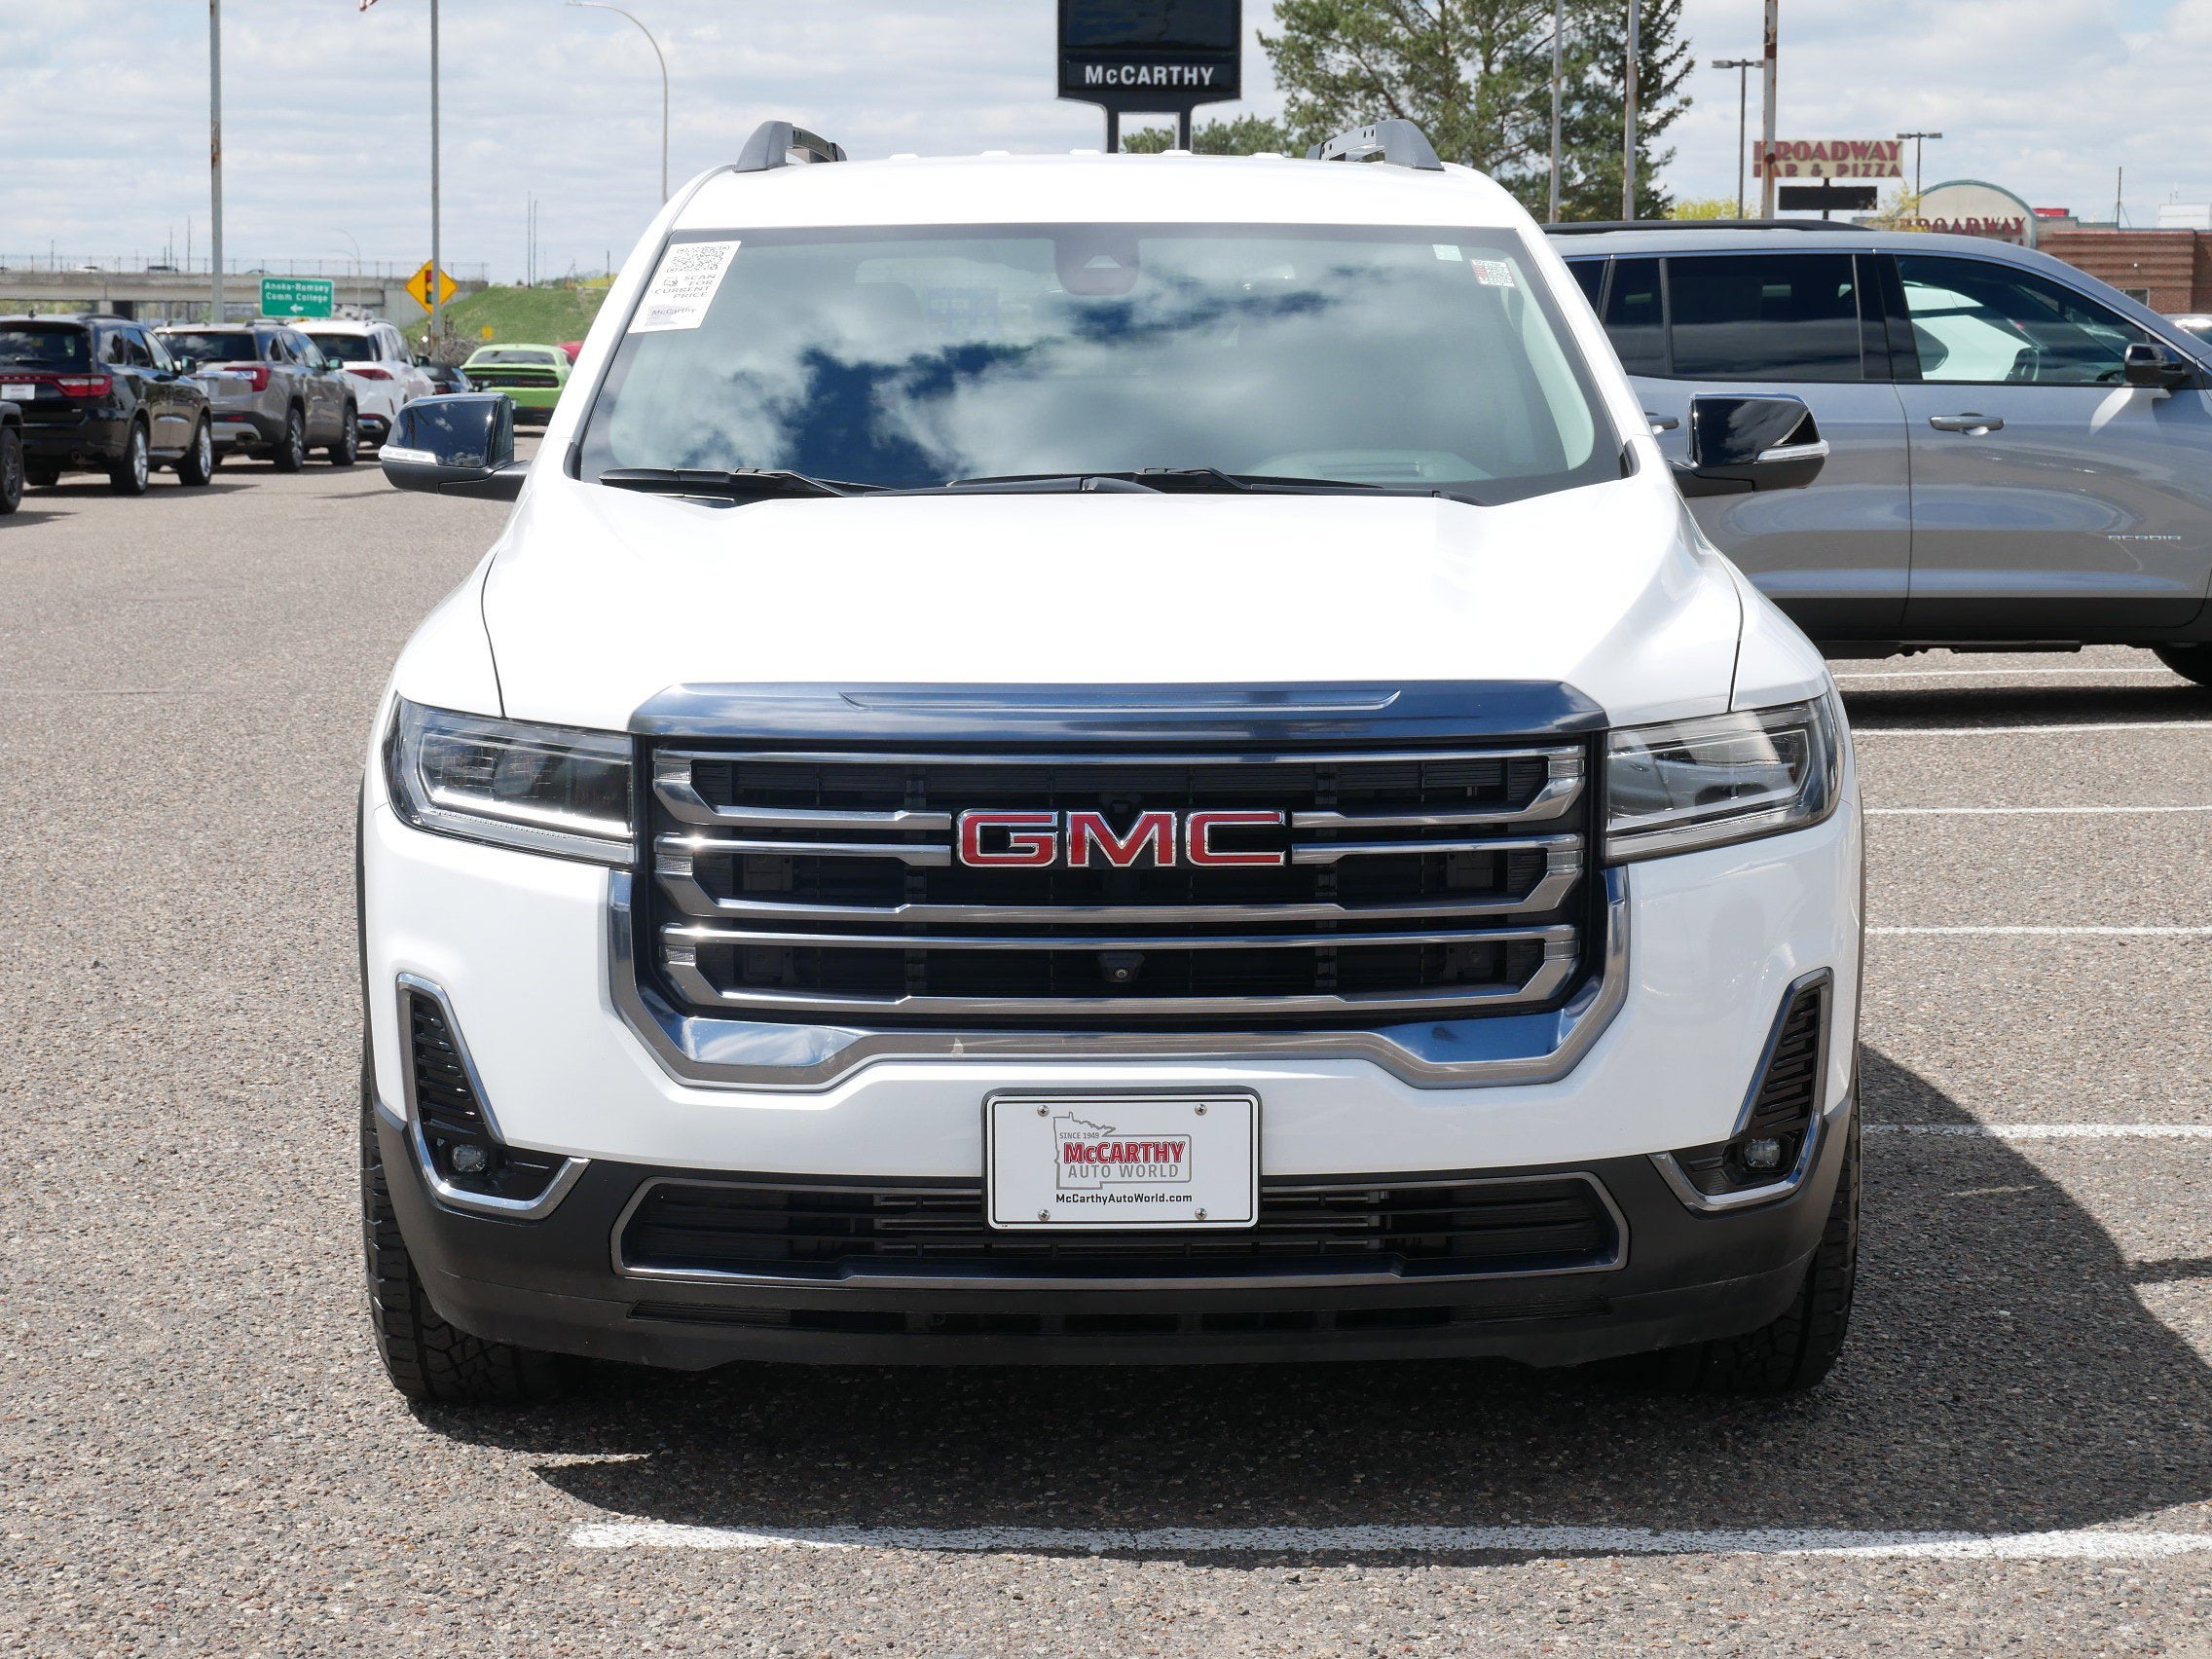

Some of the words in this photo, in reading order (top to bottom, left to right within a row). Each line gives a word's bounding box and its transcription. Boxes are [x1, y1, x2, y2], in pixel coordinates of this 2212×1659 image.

[1085, 64, 1214, 86] McCARTHY
[1811, 163, 1823, 177] &
[1835, 163, 1901, 177] PIZZA
[296, 293, 328, 303] College
[957, 808, 1286, 867] GMC
[1063, 1141, 1185, 1164] McCARTHY
[1067, 1164, 1111, 1178] AUTO
[1120, 1164, 1179, 1177] WORLD
[1055, 1194, 1193, 1205] McCarthyAutoWorld.com
